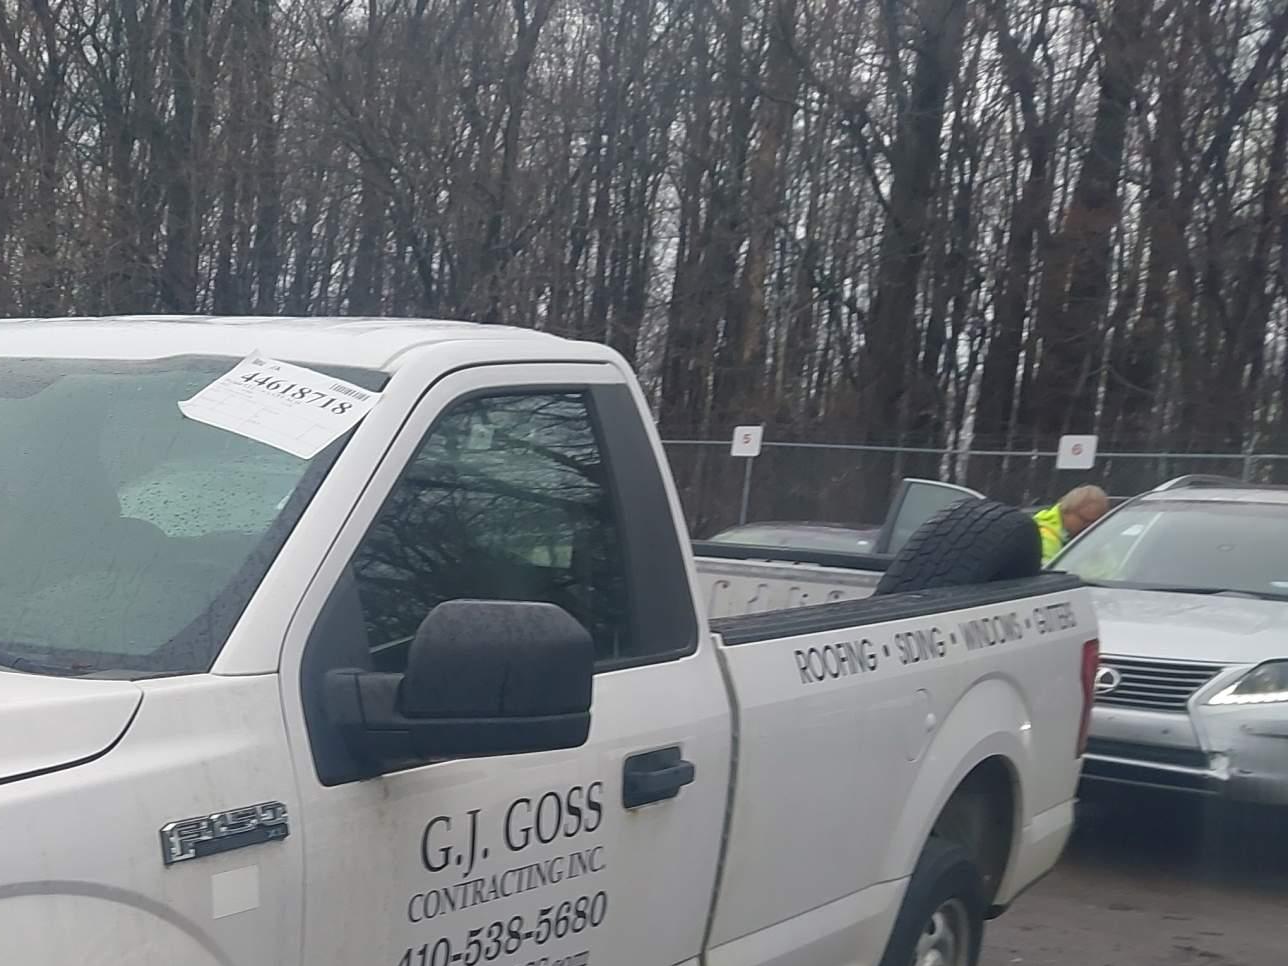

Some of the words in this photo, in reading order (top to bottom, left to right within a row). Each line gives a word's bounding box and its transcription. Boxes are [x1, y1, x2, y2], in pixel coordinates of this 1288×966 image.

[241, 372, 353, 415] 44618718
[794, 639, 879, 684] ROOFING
[894, 627, 947, 665] SIDING
[958, 612, 1023, 651] WINDOWS
[160, 800, 289, 865] F-150
[421, 808, 489, 878] G.J.
[504, 781, 604, 852] GOSS
[407, 856, 564, 923] CONTRACTING
[566, 846, 607, 879] INC
